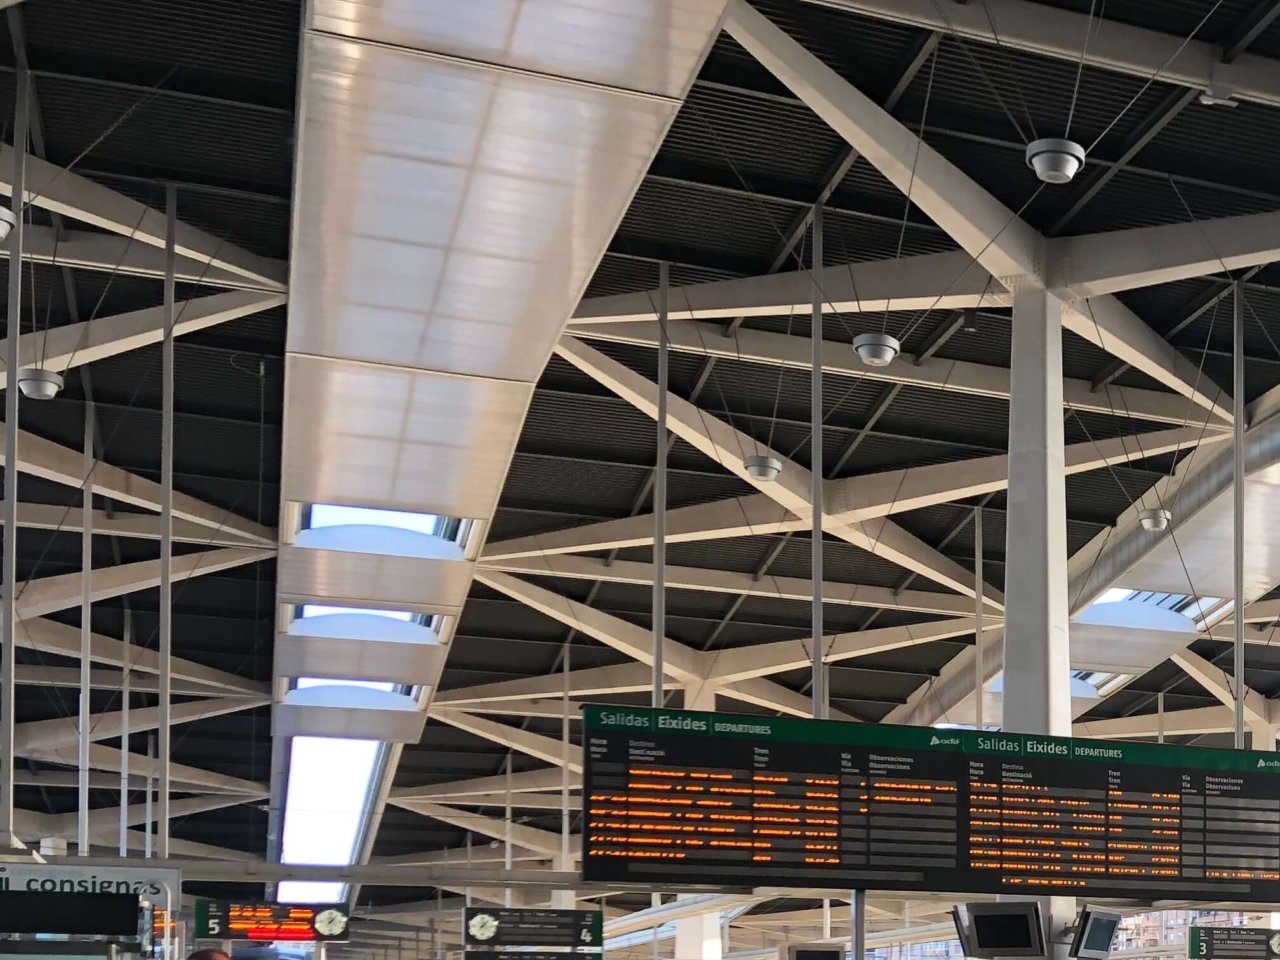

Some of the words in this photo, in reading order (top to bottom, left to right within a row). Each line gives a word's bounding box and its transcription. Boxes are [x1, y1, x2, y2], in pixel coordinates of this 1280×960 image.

[600, 712, 649, 727] Salidas
[658, 715, 707, 731] Eixides
[714, 722, 772, 735] DEPARTURES
[977, 737, 1019, 751] Salidas
[1026, 741, 1068, 755] Eixides
[1075, 747, 1123, 759] DEPARTURES
[1205, 775, 1244, 784] Observaciones
[208, 919, 220, 934] 5
[580, 928, 593, 943] 4
[1199, 942, 1207, 955] 3
